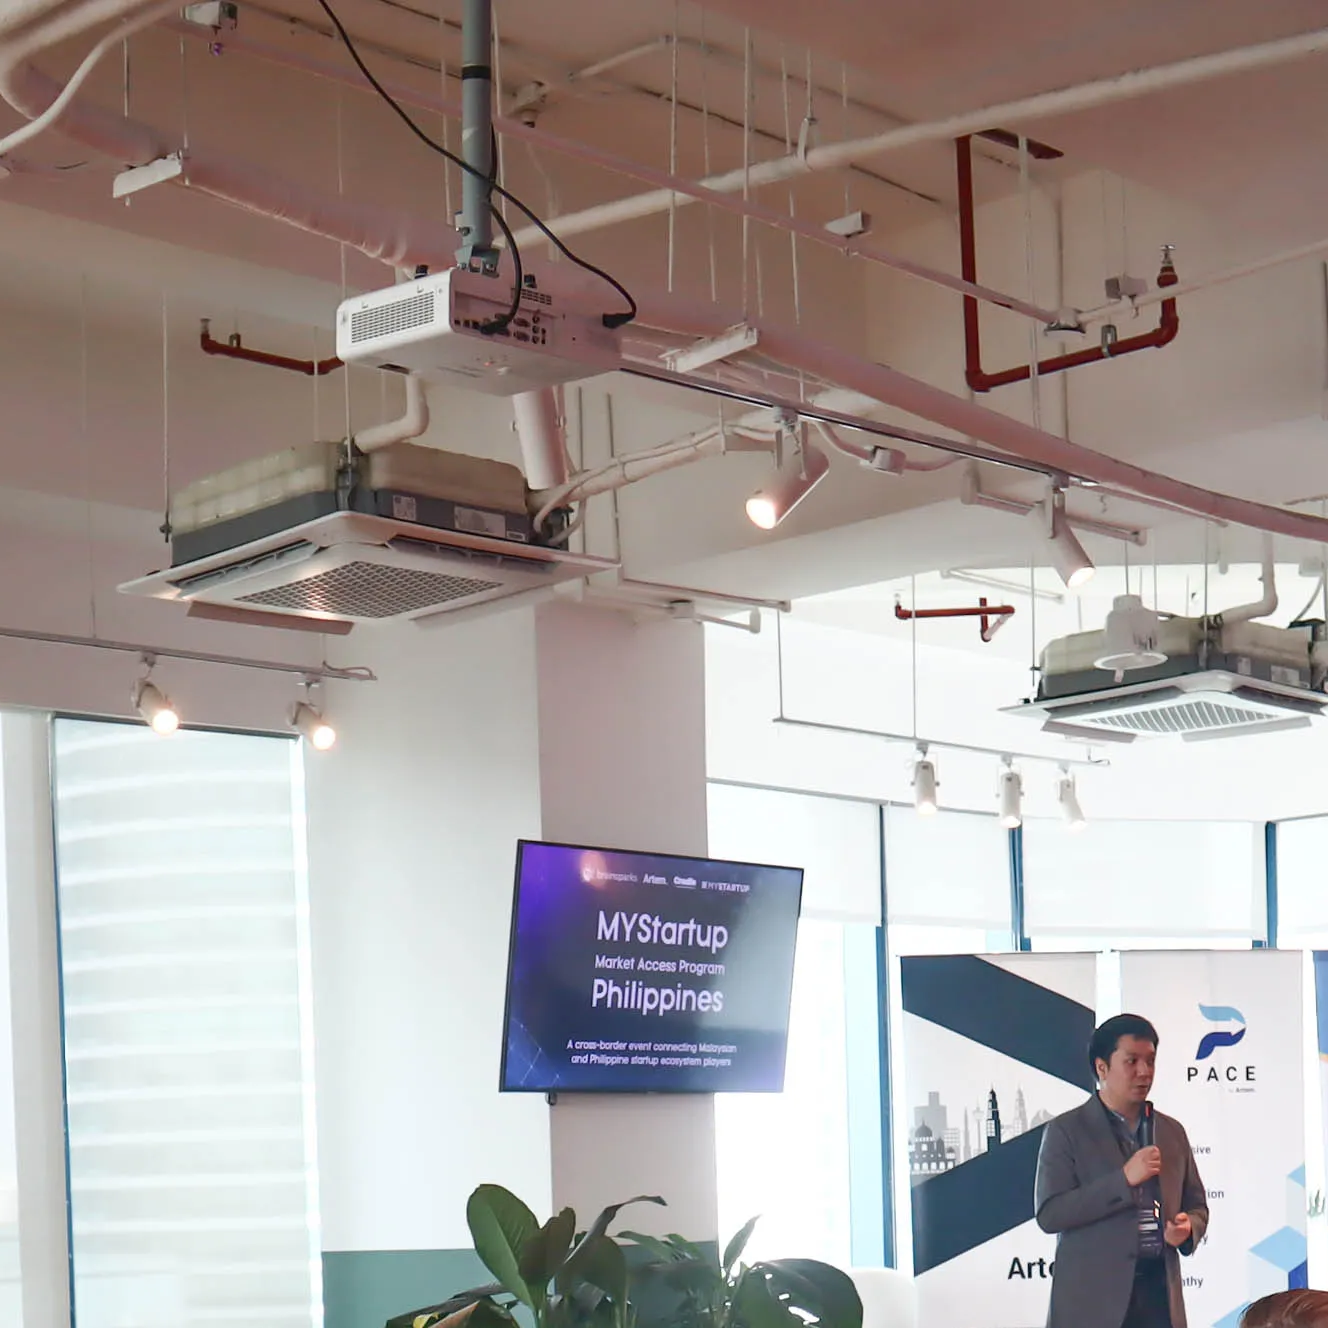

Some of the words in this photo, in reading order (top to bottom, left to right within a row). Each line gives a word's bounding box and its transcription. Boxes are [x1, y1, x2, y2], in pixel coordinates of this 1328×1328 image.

[597, 911, 729, 954] MYStartup
[595, 954, 635, 970] Market
[637, 957, 677, 972] Access
[679, 959, 726, 976] Program
[592, 978, 724, 1016] Philippines
[565, 1039, 573, 1050] A
[628, 1042, 652, 1051] event
[570, 1054, 589, 1064] and
[589, 1054, 630, 1066] Philippine
[1186, 1065, 1256, 1082] PACE
[1207, 1189, 1225, 1200] ion
